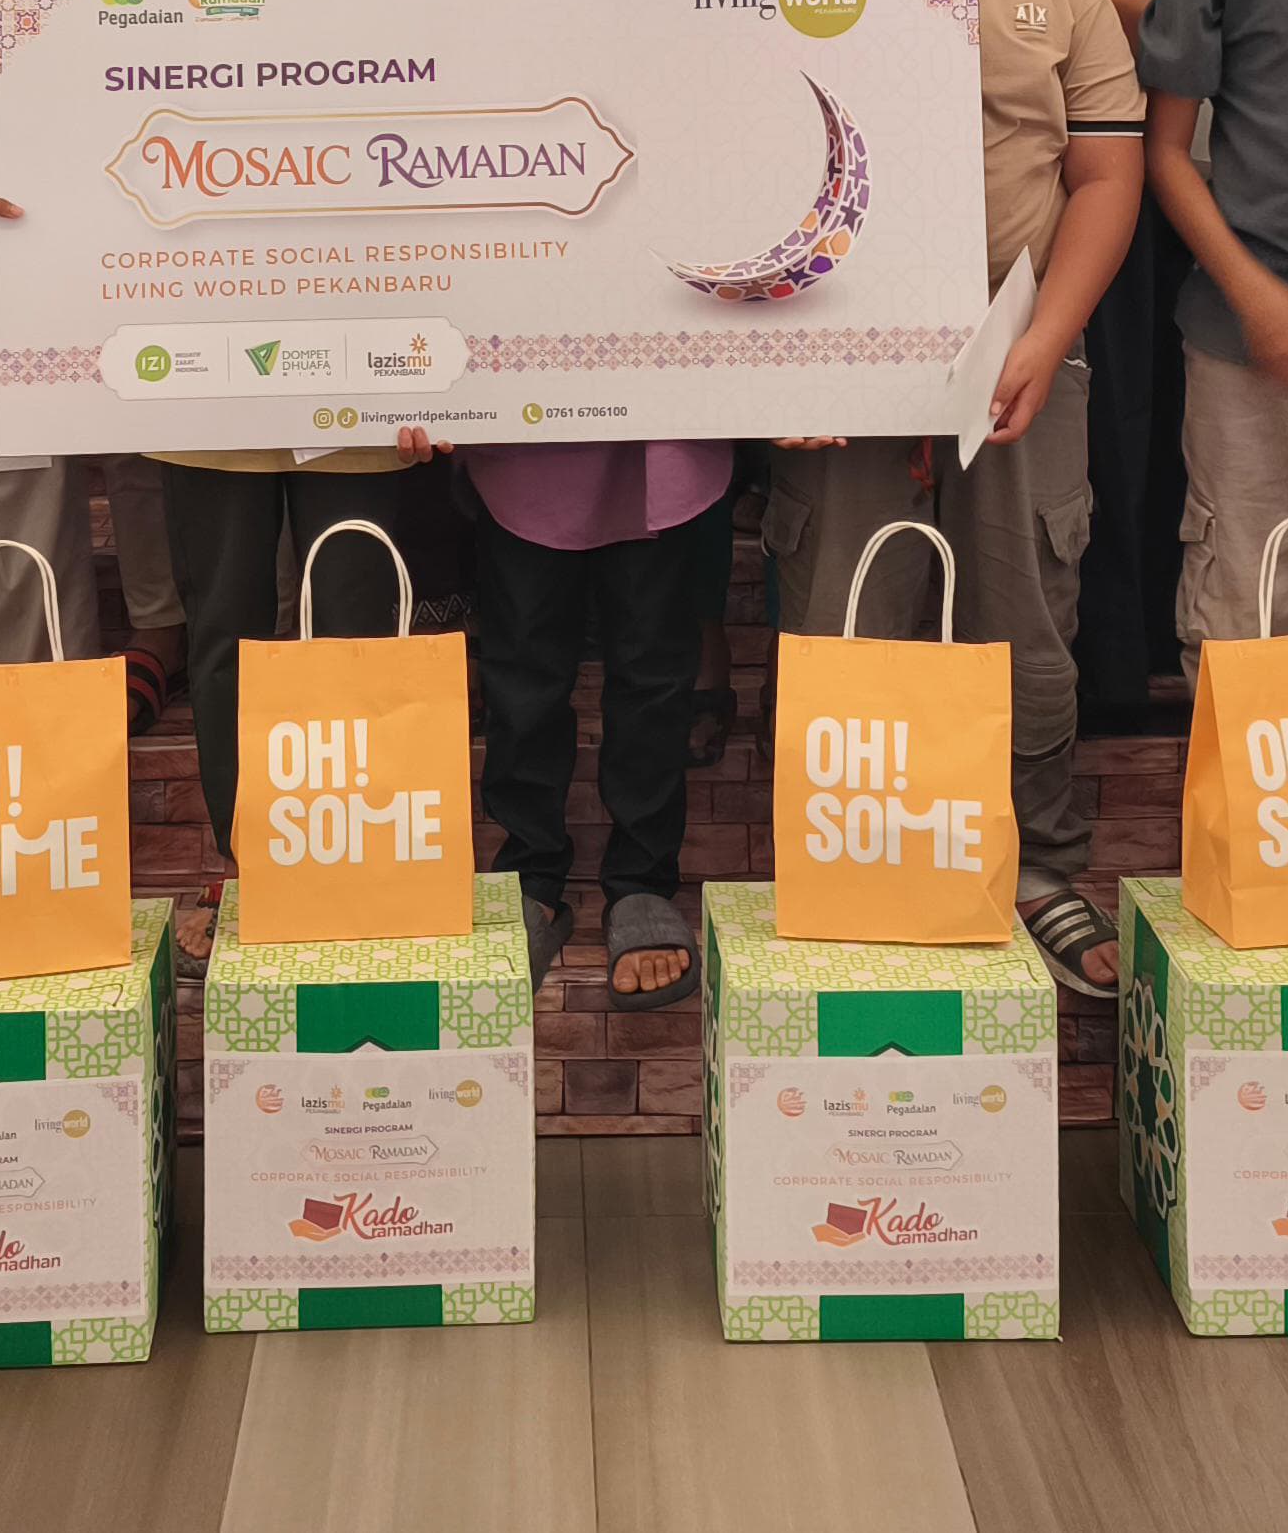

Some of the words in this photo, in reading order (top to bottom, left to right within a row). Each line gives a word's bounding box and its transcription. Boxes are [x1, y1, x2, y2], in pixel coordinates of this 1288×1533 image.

[98, 9, 184, 29] Pegadaian
[104, 63, 244, 92] SINERGI
[256, 58, 437, 87] PROGRAM
[141, 135, 352, 197] MOSAIC
[366, 133, 587, 189] RAMADAN
[101, 249, 256, 270] CORPORATE
[265, 246, 355, 266] SOCIAL
[365, 240, 569, 263] RESPONSIBILITY
[101, 281, 184, 301] LIVING
[195, 278, 286, 298] WORLD
[296, 274, 453, 295] PEKANBARU
[141, 355, 165, 371] IZI
[282, 349, 332, 360] DOMPET
[367, 352, 432, 369] lazismu
[282, 360, 331, 371] DHUAFA
[374, 368, 426, 377] PEKANBARU
[361, 409, 497, 425] livingworldpekanbaru
[546, 407, 574, 419] 0761
[577, 406, 628, 418] 6706100
[267, 718, 369, 791] OH!
[805, 715, 909, 791] OH!
[268, 790, 442, 866] SOME
[805, 792, 982, 873] SOME
[363, 1100, 412, 1112] Pegadaian
[887, 1104, 936, 1117] Pegadaian
[325, 1126, 362, 1135] SINERGI
[364, 1123, 413, 1133] PROGRAM
[848, 1129, 886, 1138] SINERGI
[889, 1129, 937, 1138] PROGRAM
[369, 1145, 428, 1160] RAMADAN
[251, 1172, 329, 1183] CORPORATE
[334, 1172, 379, 1182] SOCIAL
[385, 1167, 488, 1181] RESPONSIBILITY
[773, 1176, 852, 1187] CORPORATE
[858, 1177, 903, 1187] SOCIAL
[909, 1172, 1013, 1186] RESPONSIBILITY
[334, 1192, 419, 1240] Kado
[858, 1197, 944, 1246] Kado
[371, 1221, 454, 1238] ramadhan
[896, 1228, 978, 1245] ramadhan
